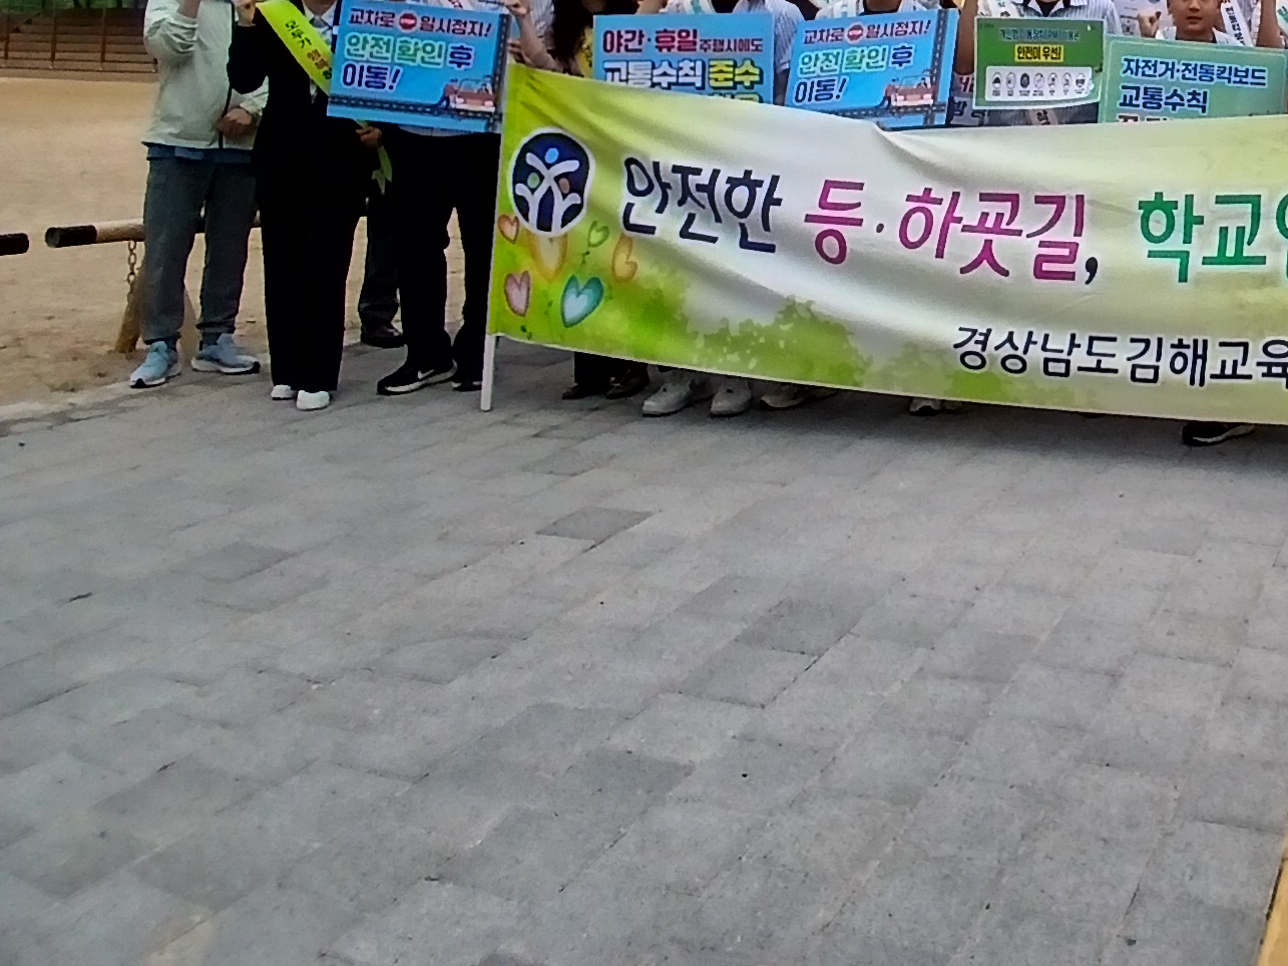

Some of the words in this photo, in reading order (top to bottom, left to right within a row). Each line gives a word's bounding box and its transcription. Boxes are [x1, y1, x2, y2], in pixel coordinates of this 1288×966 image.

[349, 7, 395, 27] 교차로
[419, 16, 492, 38] 일시정지!
[803, 27, 846, 45] 교차로
[866, 19, 932, 40] 일시정지!
[345, 34, 393, 62] 안전
[394, 37, 445, 68] 확인
[447, 43, 475, 70] 후
[699, 37, 764, 53] 주행시에도
[798, 48, 843, 77] 안전
[842, 44, 889, 73] 확인
[888, 43, 915, 70] 후
[341, 63, 402, 91] 이동!
[602, 58, 706, 90] 교통수칙
[708, 58, 765, 90] 준수
[1121, 56, 1269, 87] 자전거·전동킥보드
[793, 75, 849, 105] 이동!
[1118, 83, 1209, 114] 교통수칙
[622, 154, 784, 254] 안전한
[803, 178, 1100, 286] 등·하굣길,
